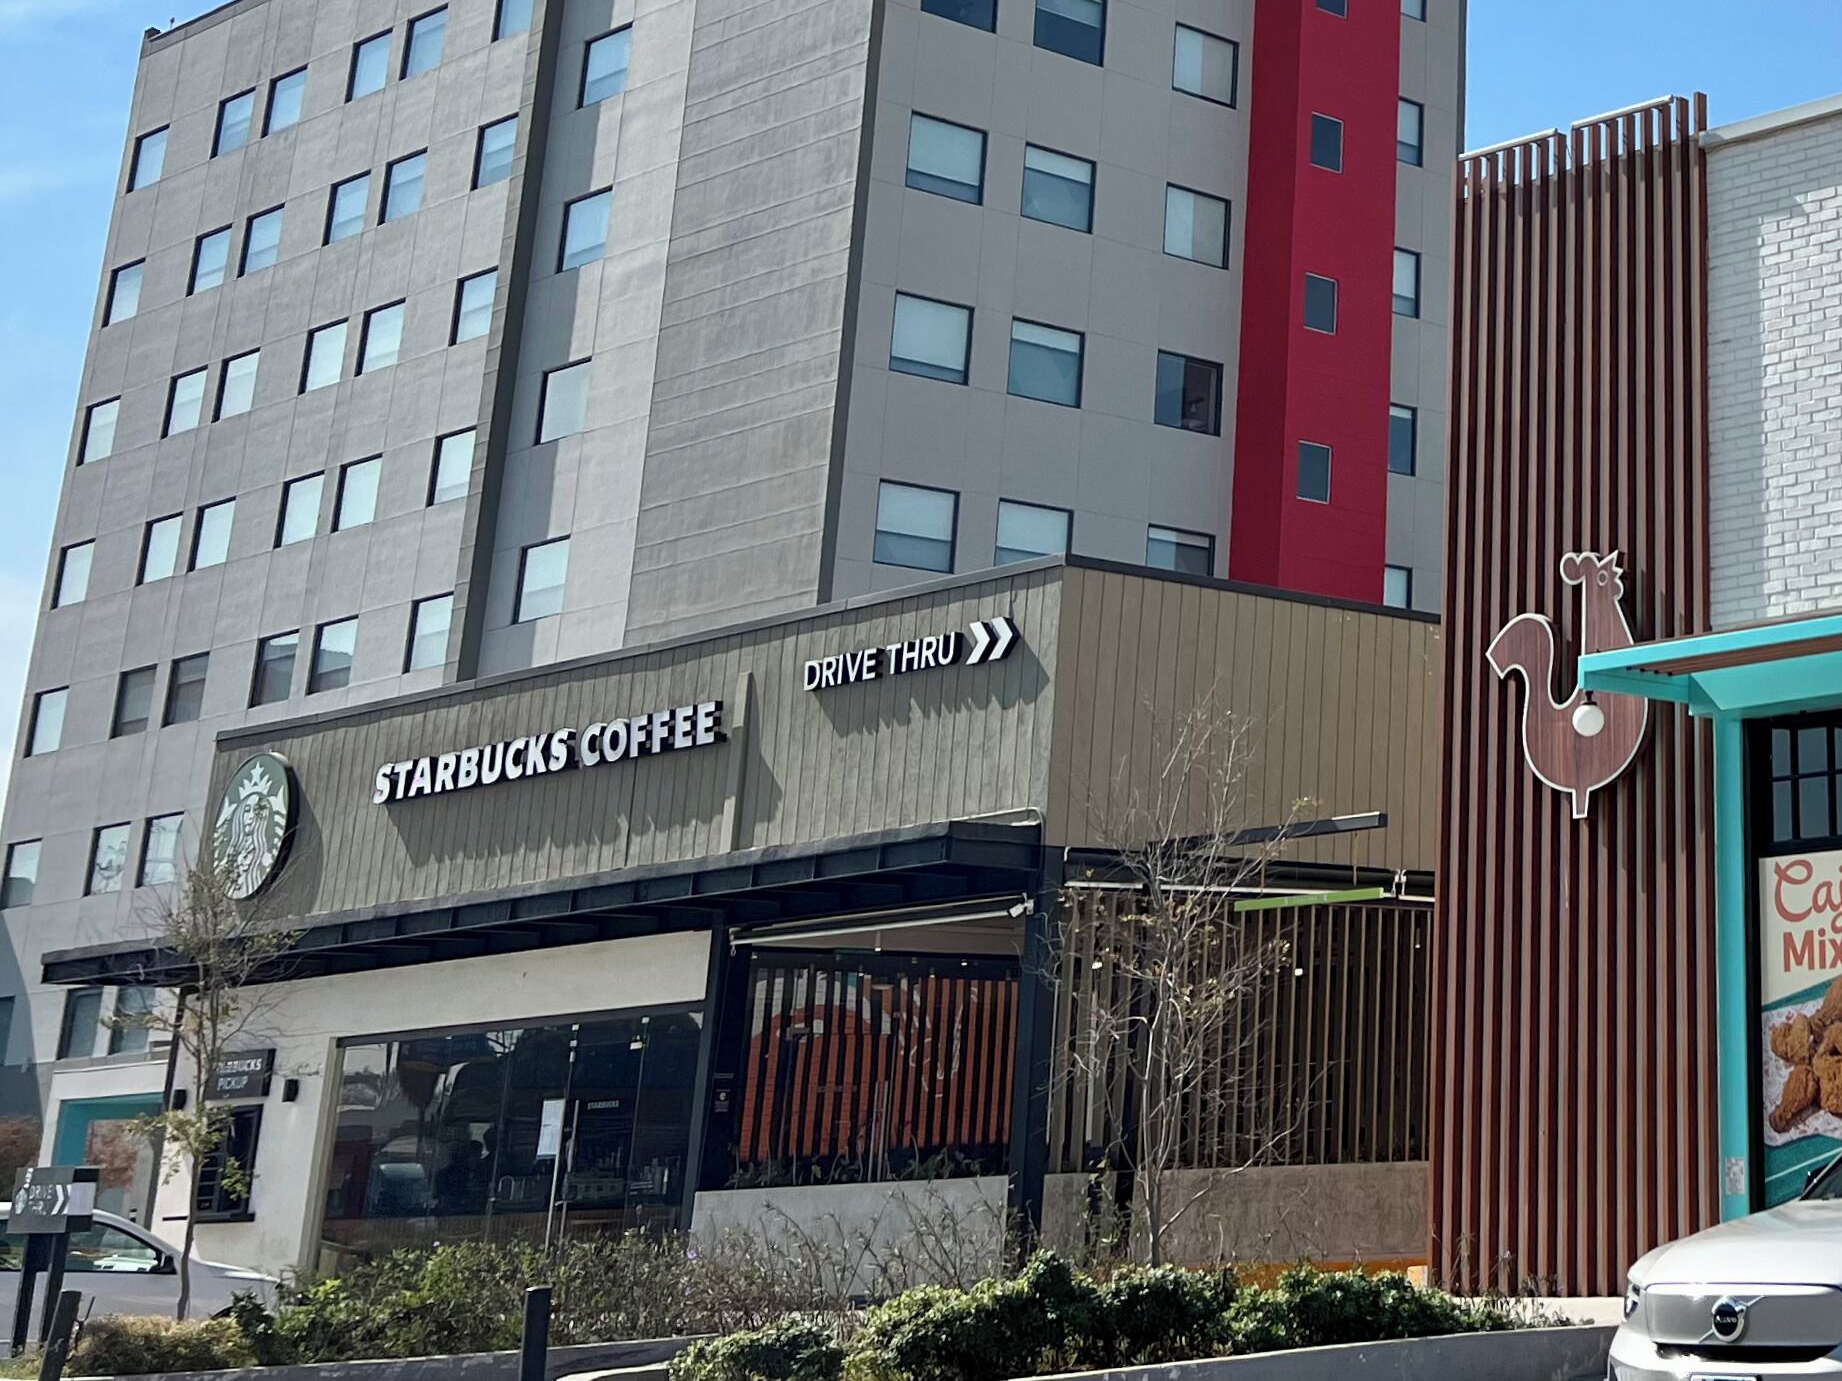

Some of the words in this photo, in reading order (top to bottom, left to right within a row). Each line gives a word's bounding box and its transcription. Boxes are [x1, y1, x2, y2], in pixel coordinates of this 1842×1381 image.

[803, 647, 879, 692] DRIVE
[886, 631, 960, 675] THRU
[372, 727, 574, 805] STARBUCKS
[581, 700, 723, 768] COFFEE
[217, 1075, 248, 1091] PICKUP
